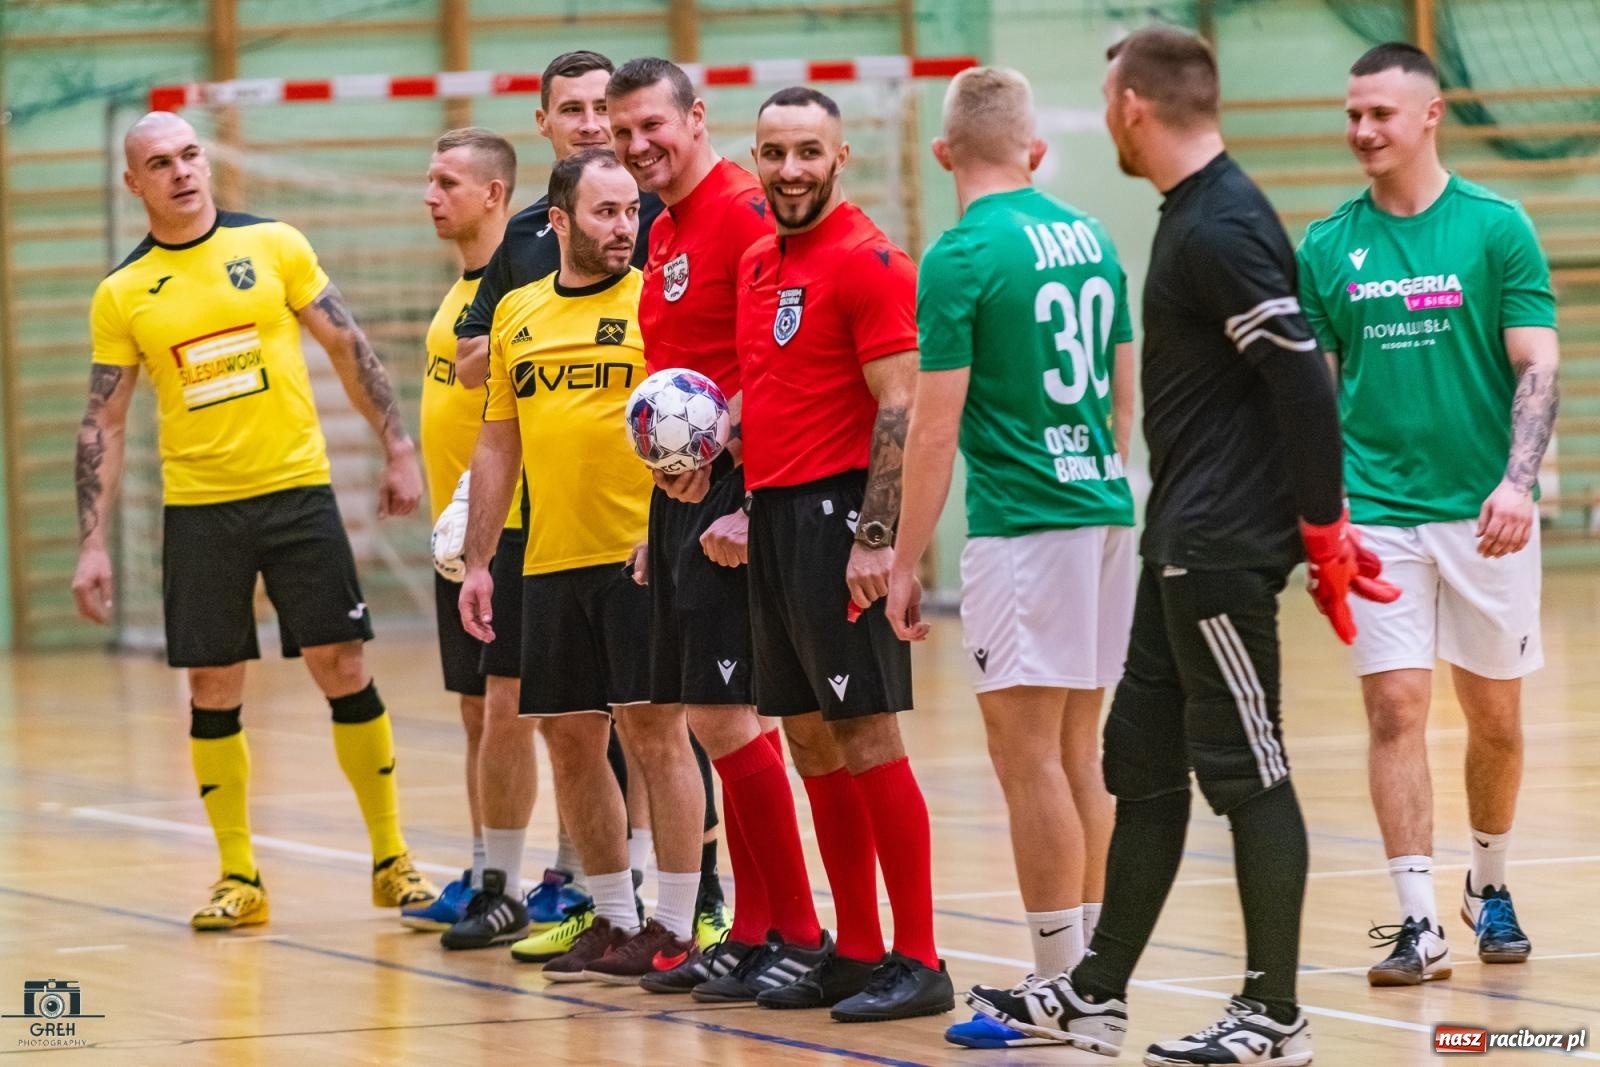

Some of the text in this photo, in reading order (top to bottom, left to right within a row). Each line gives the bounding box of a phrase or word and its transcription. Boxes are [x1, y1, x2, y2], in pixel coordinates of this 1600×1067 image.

[1024, 220, 1102, 271] JARO
[1348, 274, 1462, 302] DROGERIA
[1035, 276, 1115, 405] 30
[1044, 424, 1090, 455] OSG
